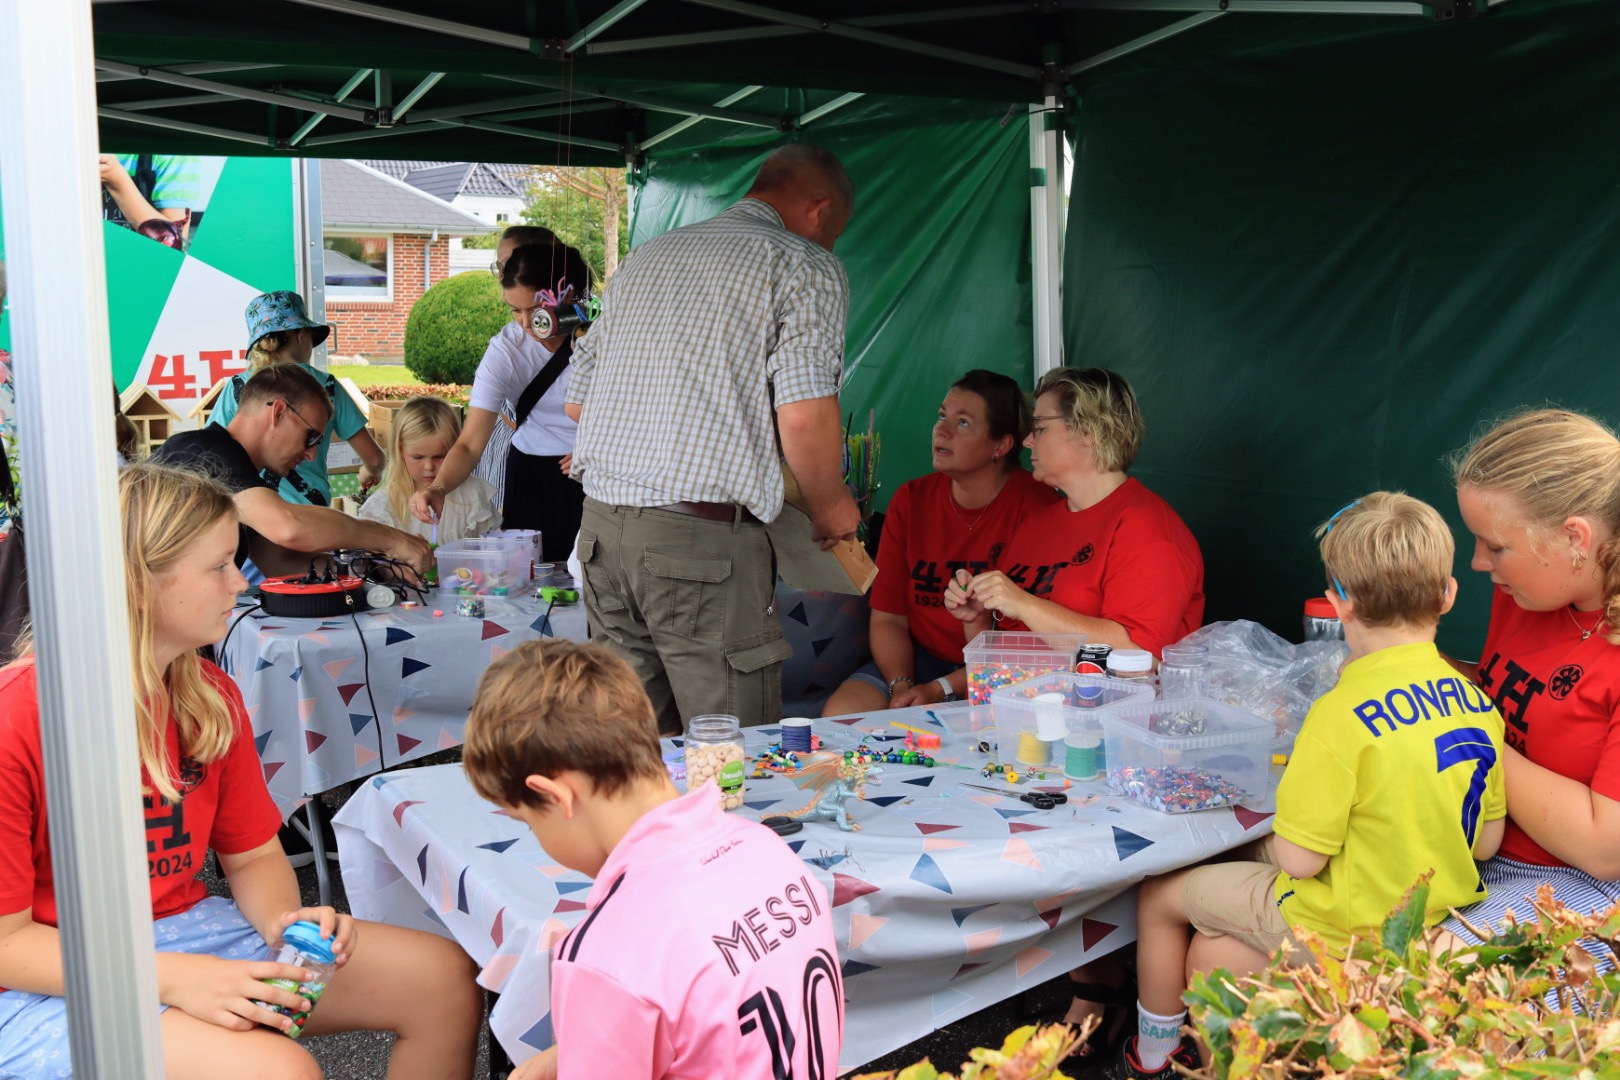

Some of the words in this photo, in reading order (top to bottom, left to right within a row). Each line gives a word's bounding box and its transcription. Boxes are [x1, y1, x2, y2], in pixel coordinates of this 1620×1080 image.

[914, 594, 946, 607] 192
[1353, 678, 1494, 737] RONALD
[1434, 727, 1497, 892] 7
[712, 875, 821, 977] MESSI
[737, 948, 842, 1080] 10
[1141, 1017, 1180, 1040] GAM
